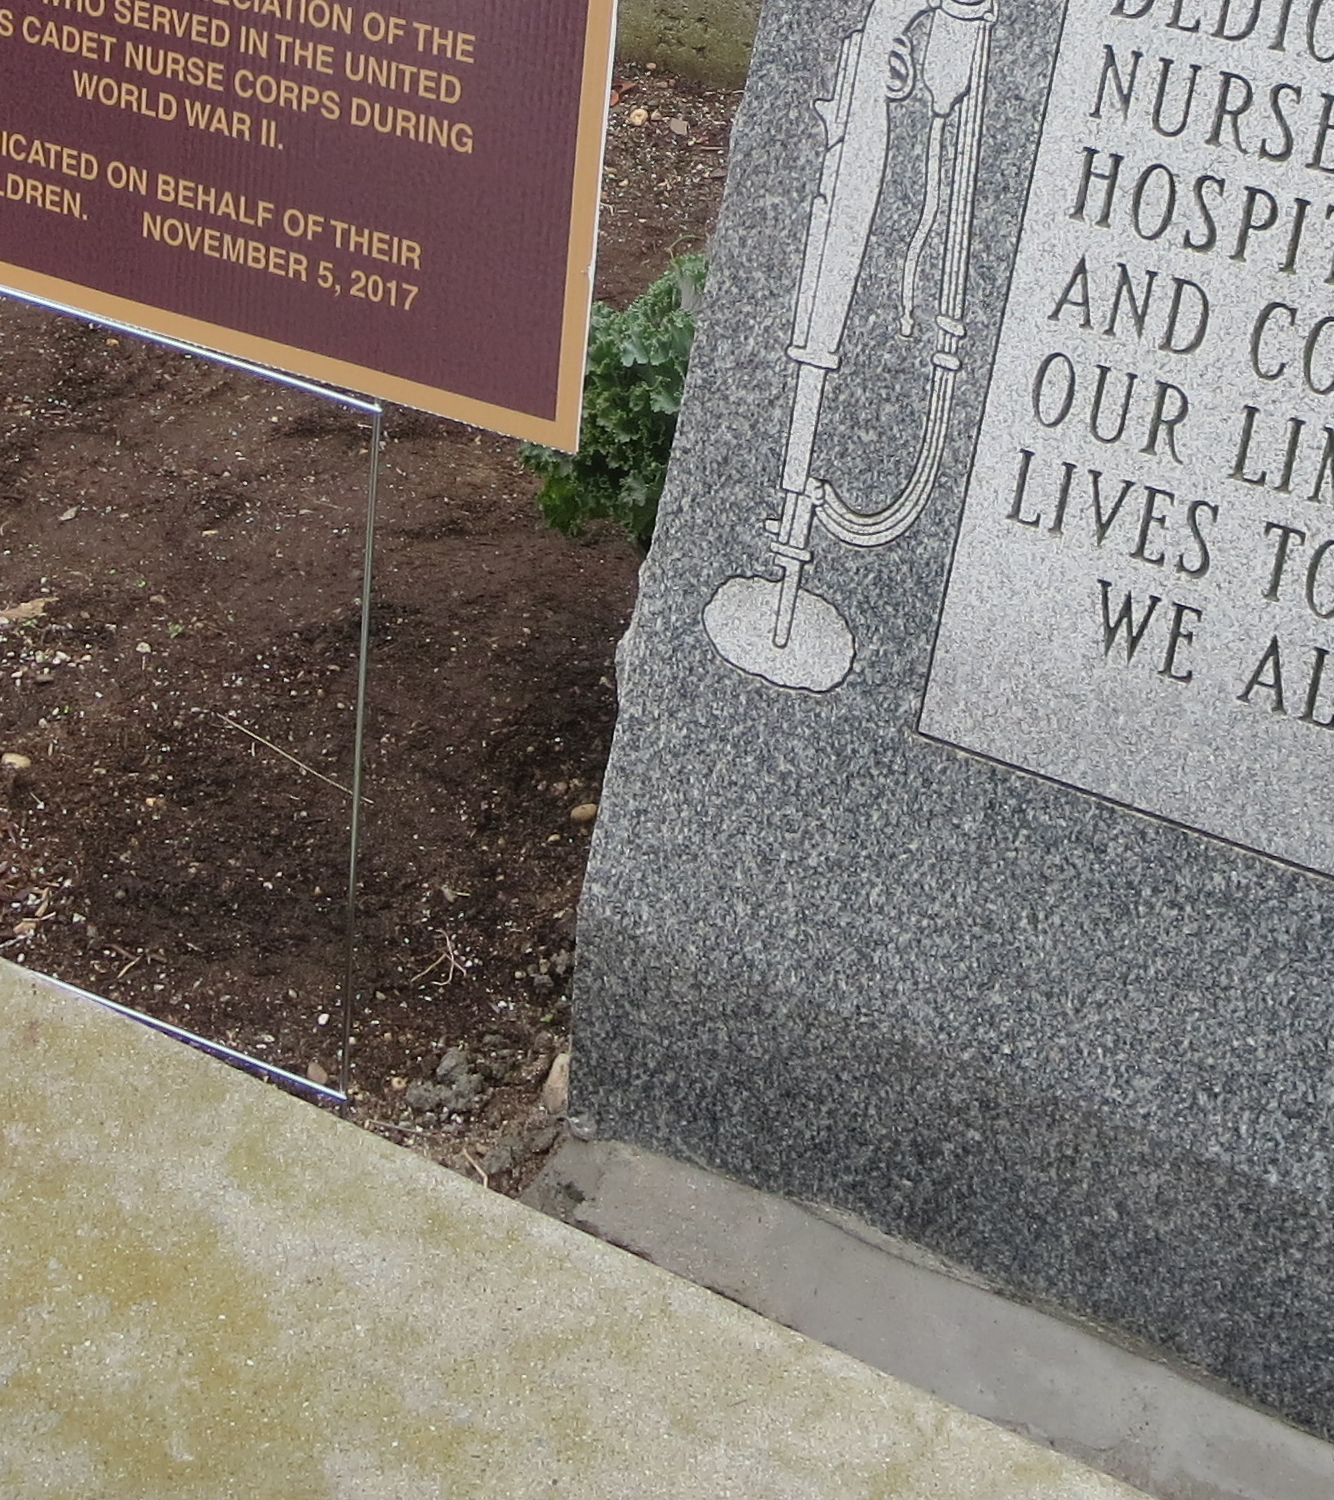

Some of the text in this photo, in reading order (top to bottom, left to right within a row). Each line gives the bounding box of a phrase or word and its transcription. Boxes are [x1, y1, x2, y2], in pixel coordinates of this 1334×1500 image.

[23, 16, 116, 60] CADET
[125, 44, 224, 90] NURSE
[235, 70, 340, 119] CORPS
[351, 97, 472, 152] DURING
[240, 27, 268, 56] IN
[275, 34, 334, 73] THE
[346, 54, 461, 103] UNITED
[363, 12, 406, 41] OF
[414, 23, 475, 62] THE
[74, 72, 286, 150] WORLD WAR II.
[107, 161, 147, 193] ON
[158, 174, 274, 225] BEHALF
[283, 209, 324, 236] OF
[331, 220, 421, 268] THEIR
[143, 213, 307, 279] NOVEMBER
[318, 261, 342, 297] 5,
[350, 270, 418, 308] 2017
[1048, 255, 1211, 354] AND
[1032, 352, 1190, 463] OUR
[1006, 448, 1219, 580] LIVES
[1096, 580, 1204, 684] WE
